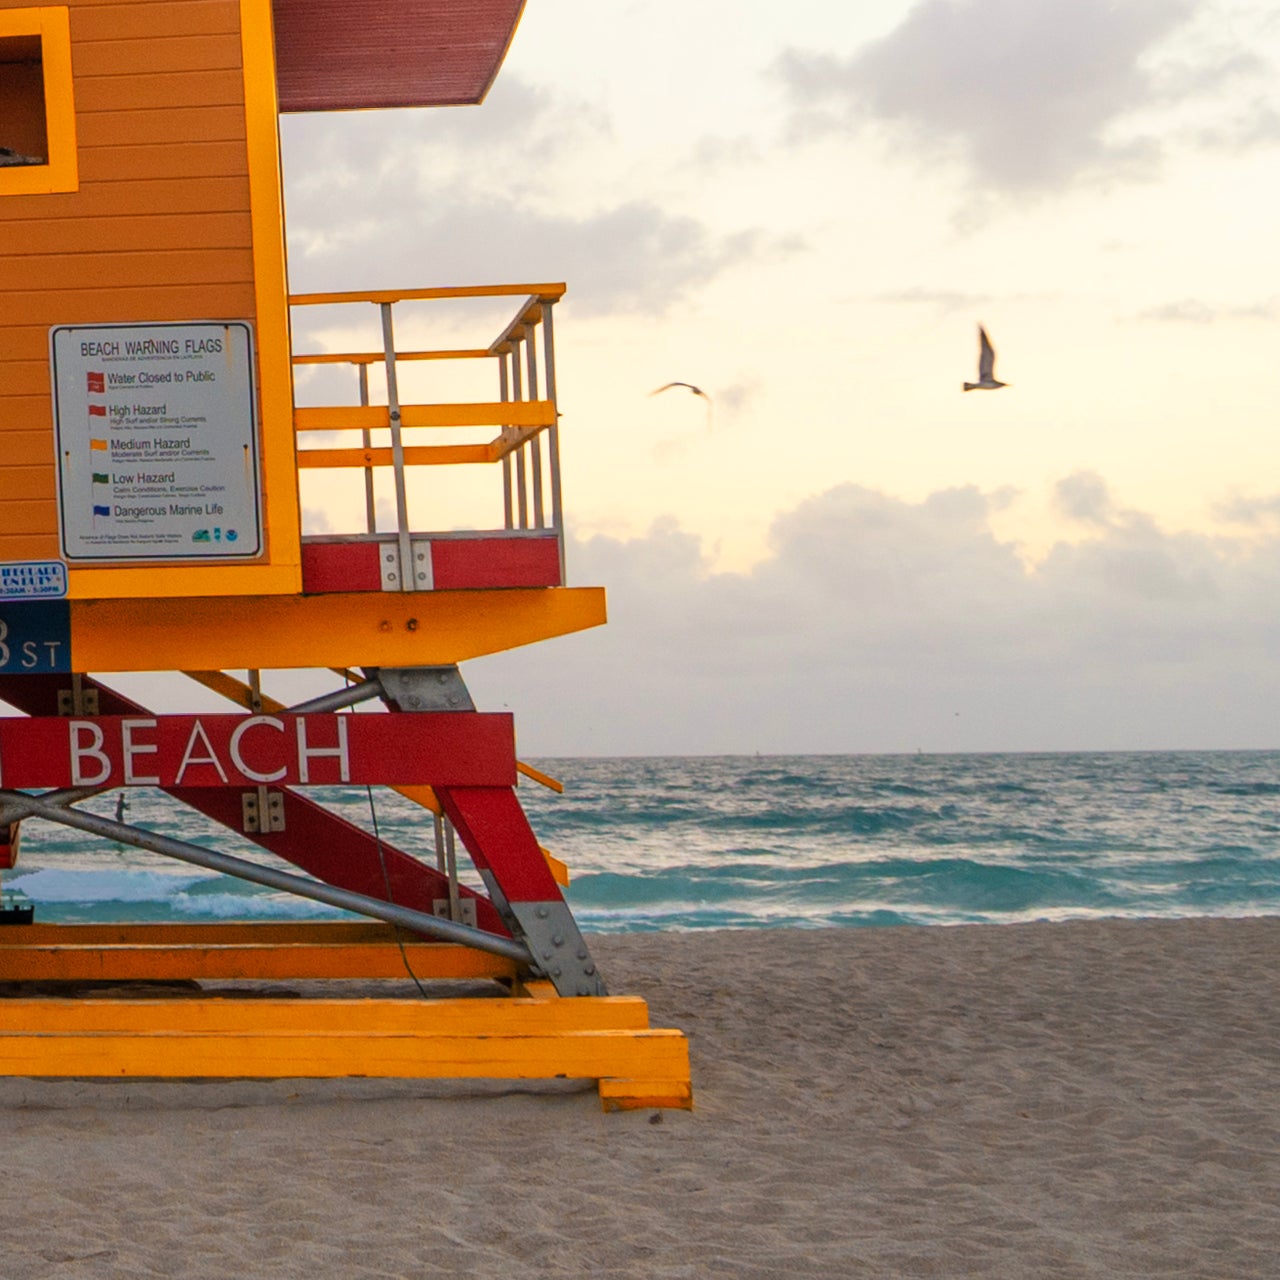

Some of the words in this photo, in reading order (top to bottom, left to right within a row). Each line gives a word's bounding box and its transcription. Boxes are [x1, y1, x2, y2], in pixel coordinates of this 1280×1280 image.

[80, 342, 120, 356] BEACH
[125, 339, 180, 355] WARNING
[185, 338, 223, 353] FLAGS
[107, 373, 136, 384] Water
[138, 372, 172, 383] Closed
[173, 372, 184, 383] to
[186, 371, 216, 382] Public
[109, 405, 131, 419] High
[133, 404, 167, 416] Hazard
[111, 438, 151, 450] Medium
[153, 437, 191, 449] Hazard
[112, 473, 135, 485] Low
[137, 472, 175, 484] Hazard
[114, 505, 167, 519] Dangerous
[169, 504, 203, 516] Marine
[205, 503, 224, 515] Life
[21, 641, 61, 668] ST
[70, 715, 350, 787] BEACH
